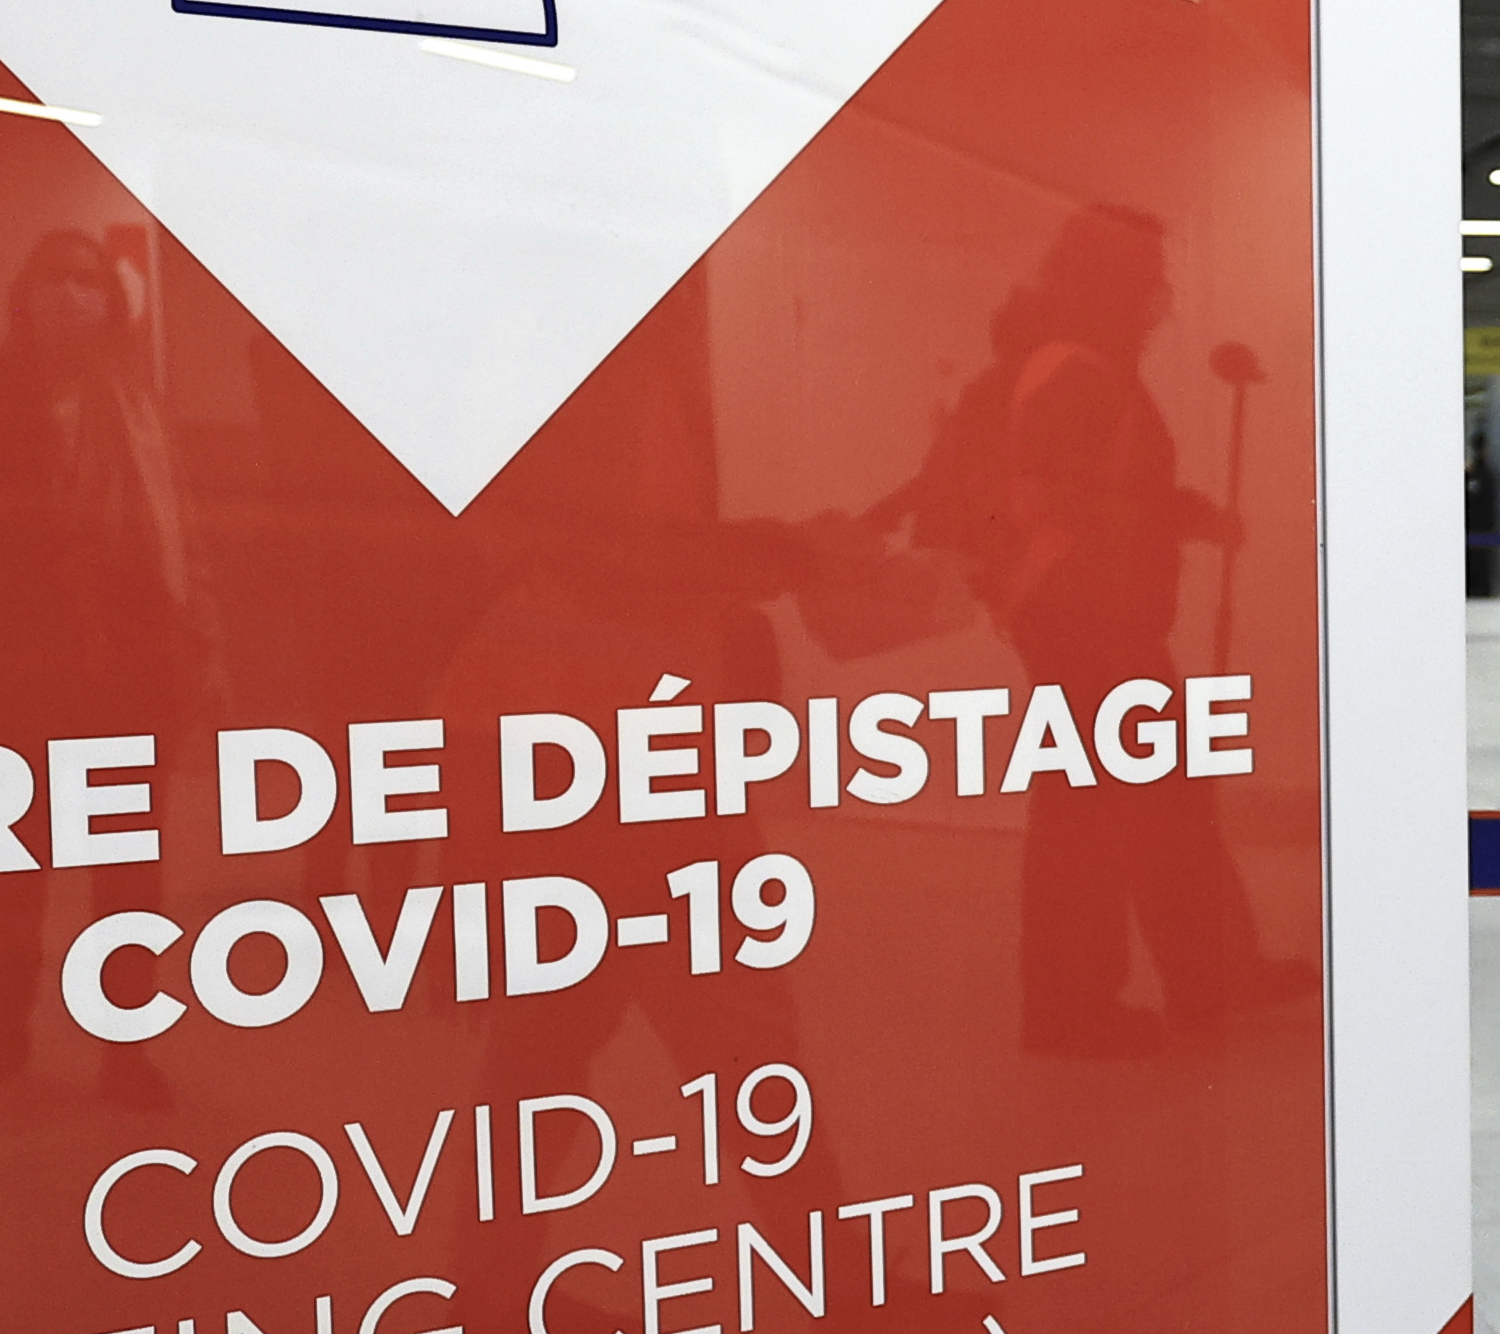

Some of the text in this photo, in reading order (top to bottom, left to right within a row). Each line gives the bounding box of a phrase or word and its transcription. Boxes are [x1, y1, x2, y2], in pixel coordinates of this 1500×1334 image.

[218, 719, 447, 854] DE
[500, 674, 1252, 832] DÉPISTAGE
[62, 854, 814, 1041] COVID-19
[85, 1064, 811, 1278] COVID-19
